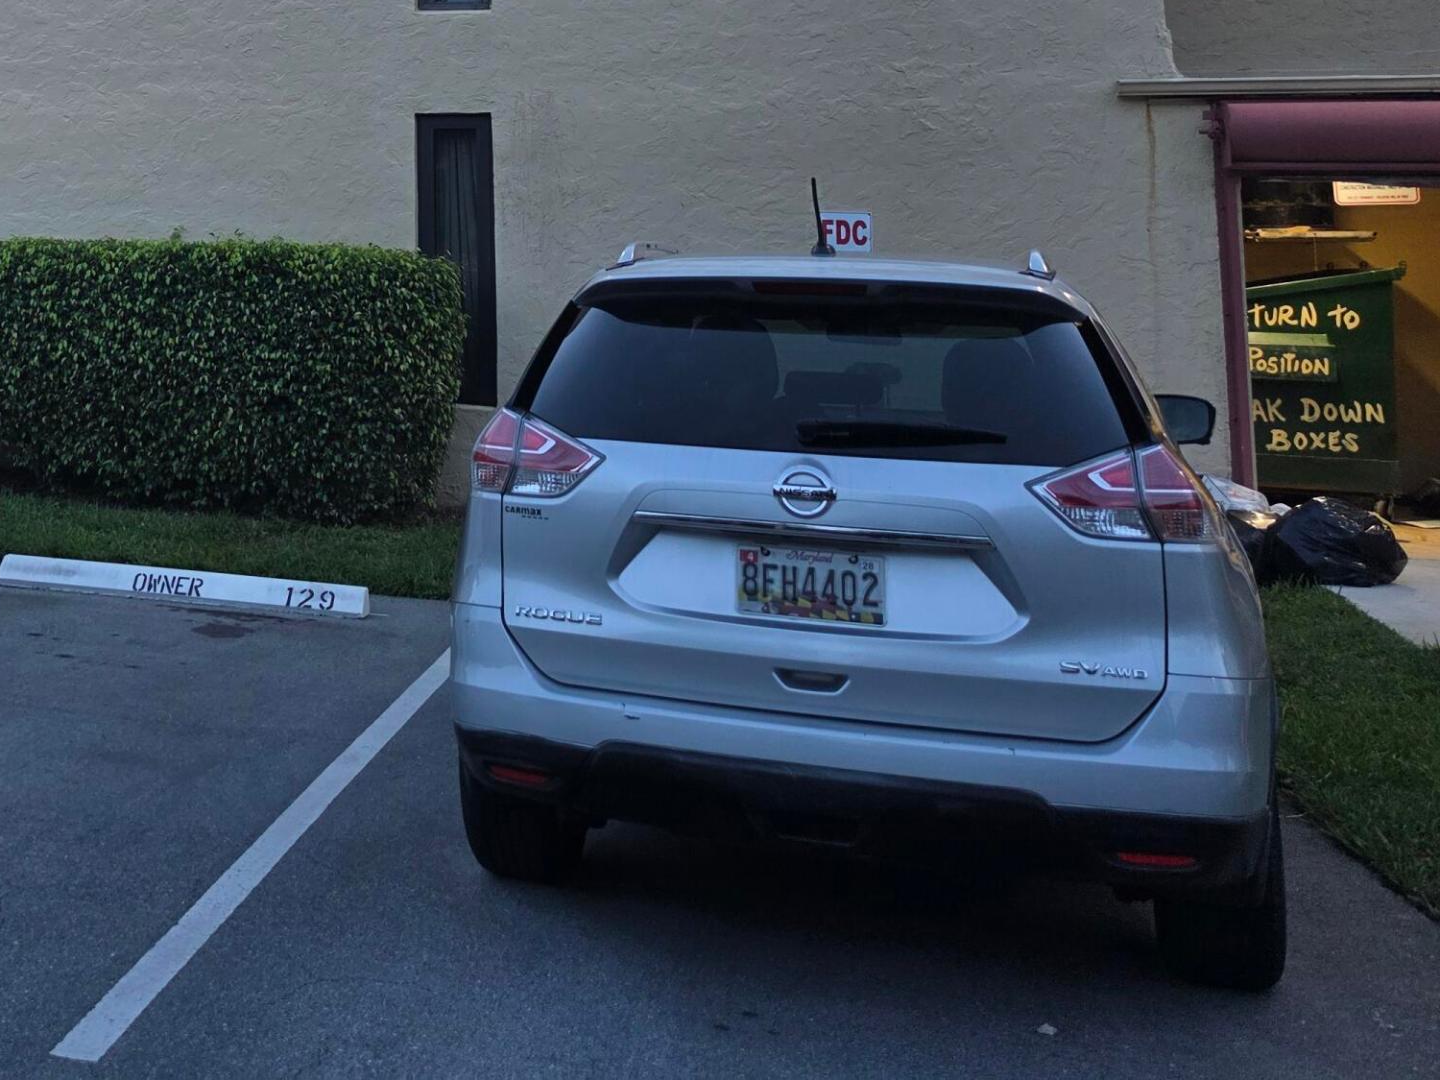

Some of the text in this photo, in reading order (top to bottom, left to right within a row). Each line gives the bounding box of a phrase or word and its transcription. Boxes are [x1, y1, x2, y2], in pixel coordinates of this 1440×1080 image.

[821, 219, 868, 246] FDC
[1247, 303, 1317, 327] TURN
[1300, 397, 1385, 424] DOWN
[1266, 429, 1360, 453] BOXES
[132, 572, 336, 611] OWNER 129
[742, 563, 880, 607] 8FH4402
[515, 605, 603, 626] ROGUE
